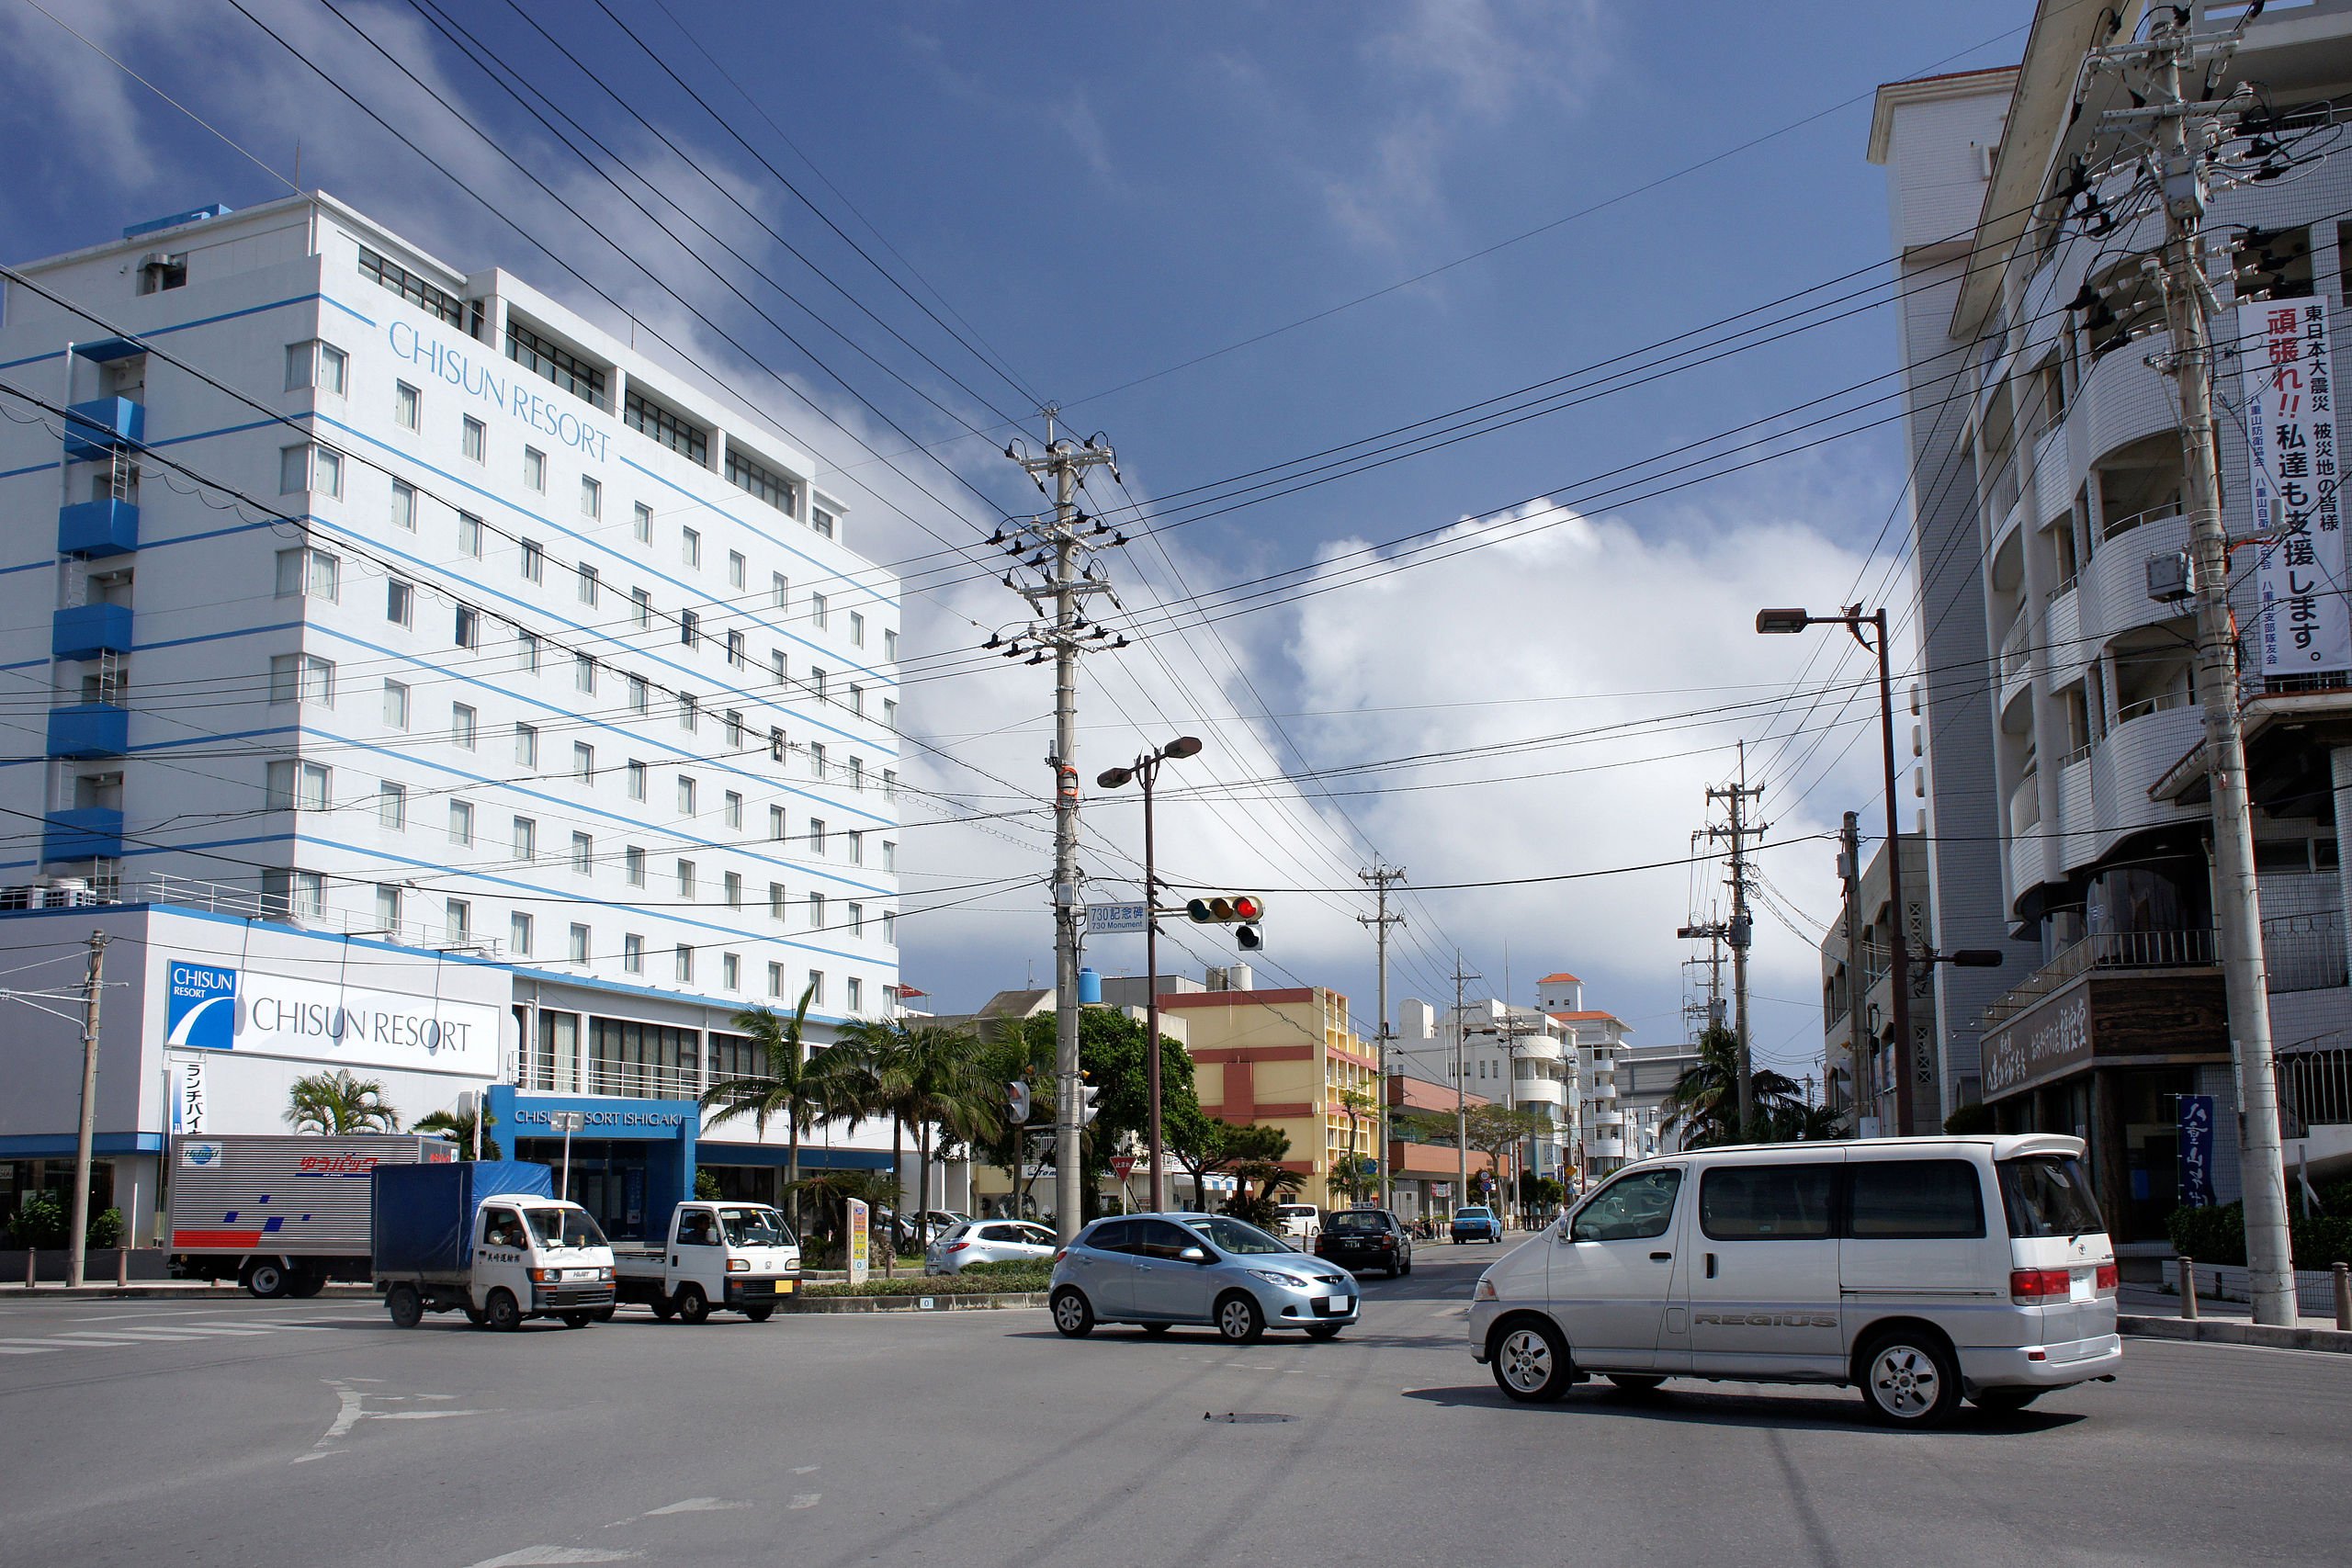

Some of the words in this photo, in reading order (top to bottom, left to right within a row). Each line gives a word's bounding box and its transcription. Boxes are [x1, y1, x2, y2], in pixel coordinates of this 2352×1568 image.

[2304, 305, 2330, 412] 東日本大震災
[390, 321, 505, 410] CHISUN
[513, 384, 611, 463] RESORT
[2313, 423, 2339, 532] 被災地の皆様
[1091, 906, 1144, 921] 730記念碑
[174, 967, 232, 990] CHISUN
[174, 986, 206, 998] RESORT
[253, 997, 366, 1041] CHISUN
[374, 1012, 471, 1052] RESORT
[623, 1112, 683, 1126] ISHIGAKI
[1694, 1314, 1838, 1328] REGIUS
